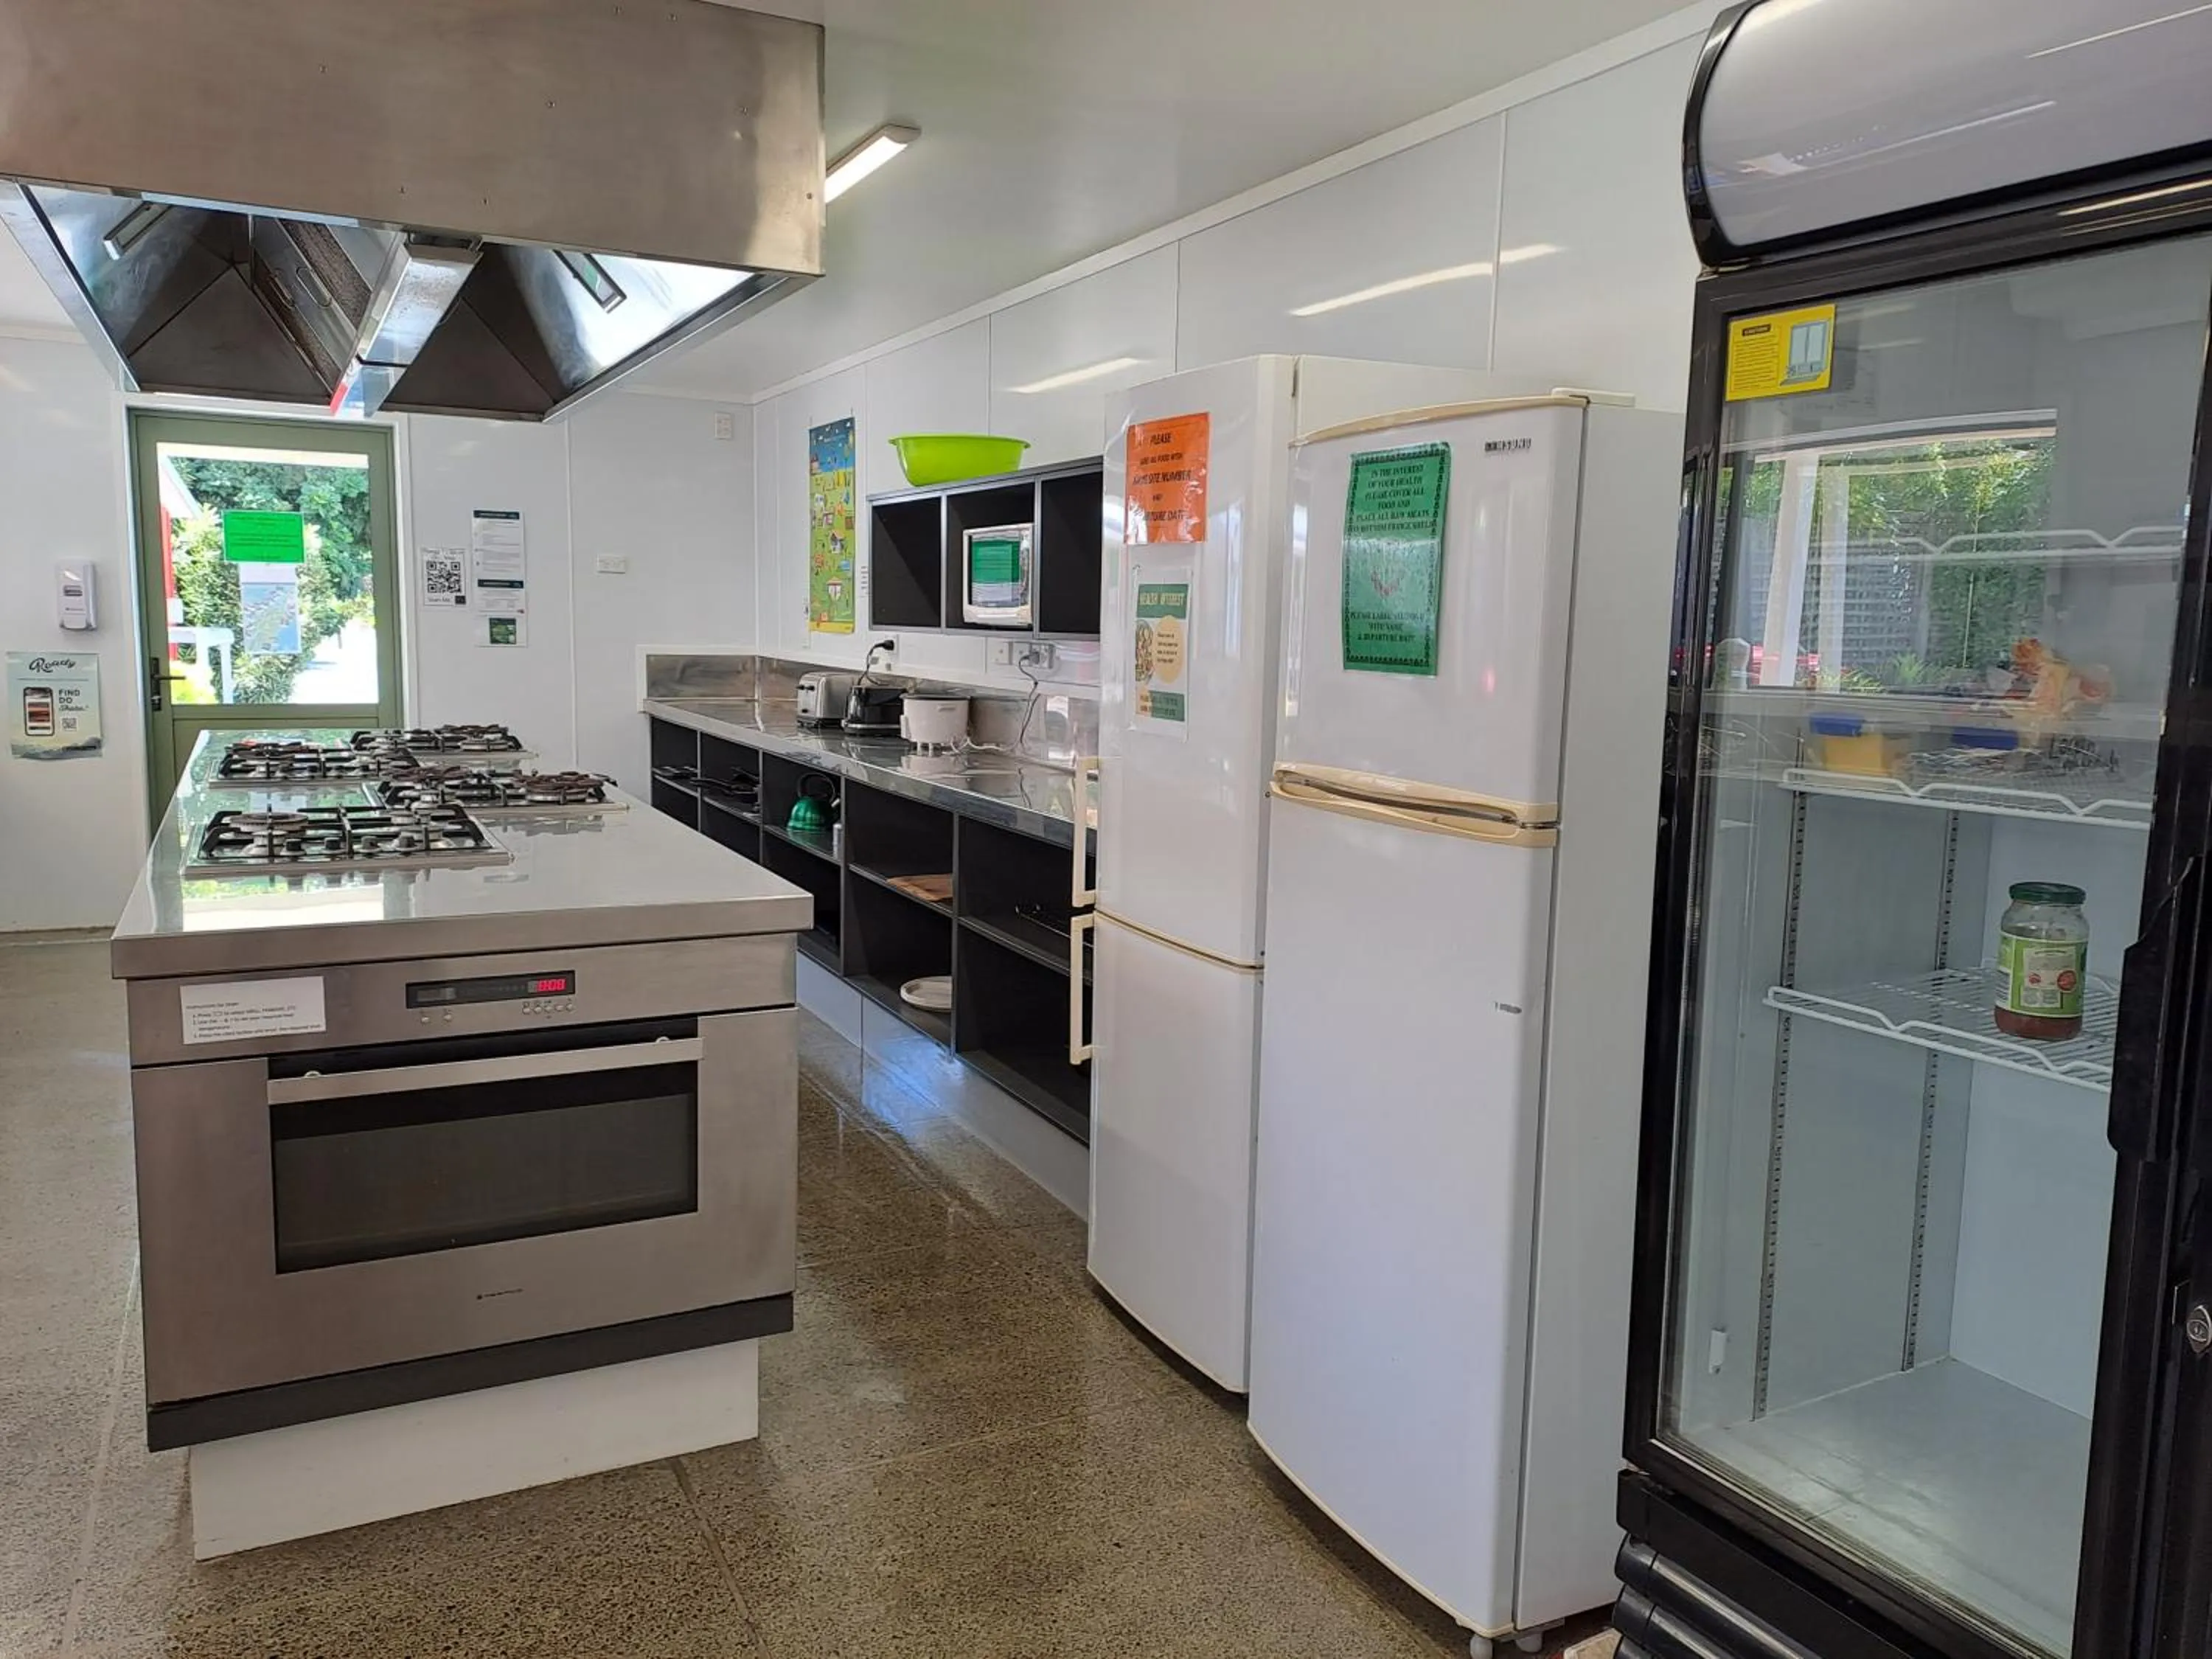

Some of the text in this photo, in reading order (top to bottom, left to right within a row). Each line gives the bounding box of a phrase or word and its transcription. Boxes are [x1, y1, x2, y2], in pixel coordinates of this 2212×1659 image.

[1393, 465, 1424, 476] INTEREST
[1377, 499, 1411, 510] FOOD AND
[29, 657, 76, 673] Roady
[58, 689, 80, 697] FIND
